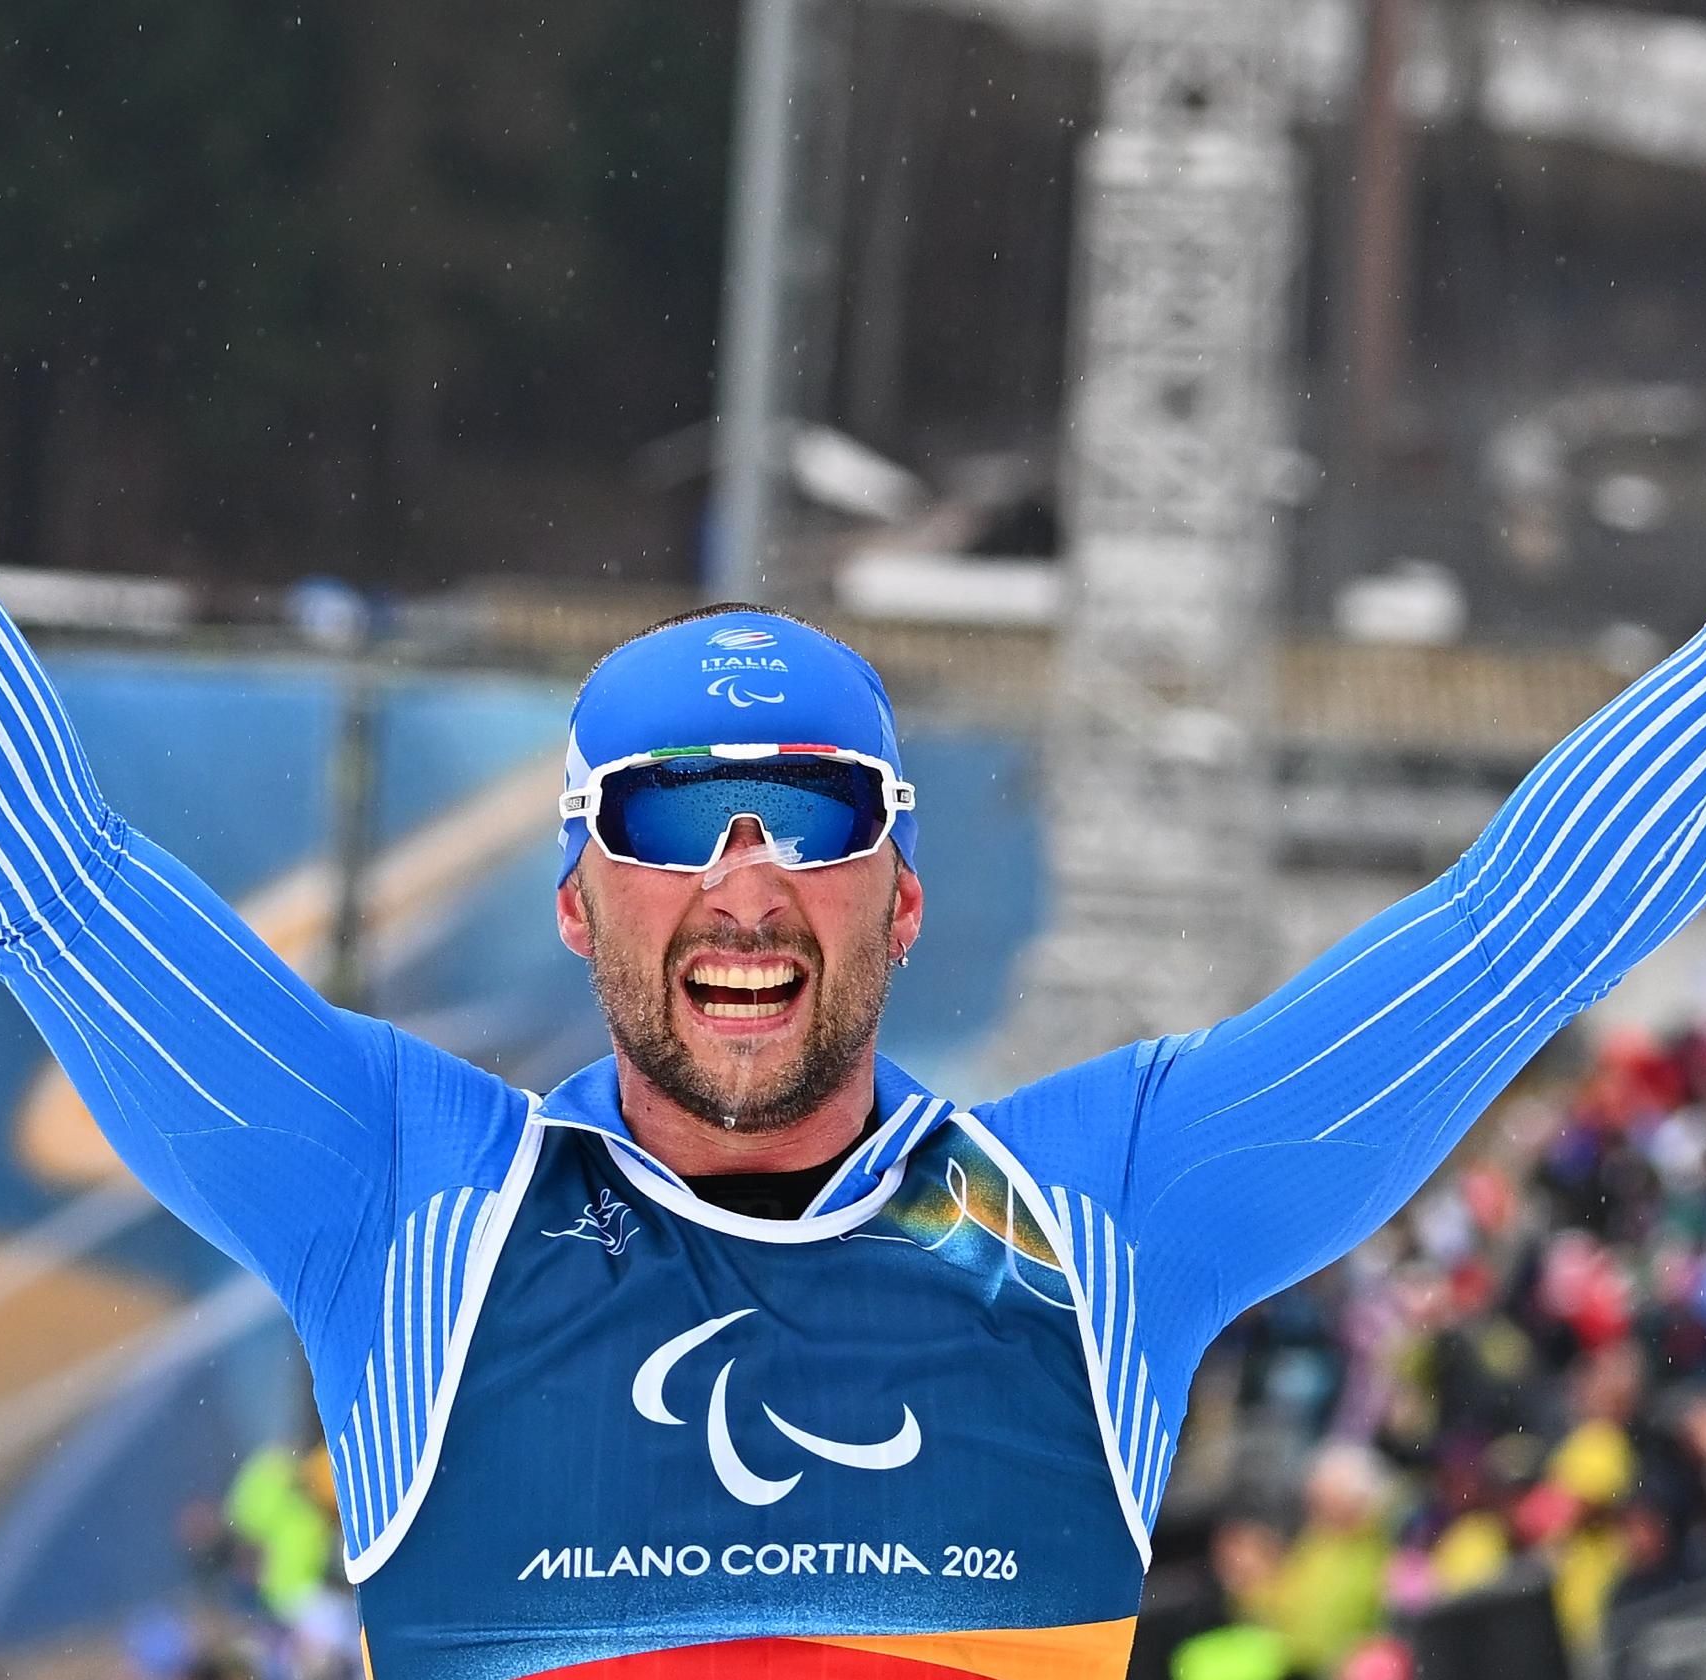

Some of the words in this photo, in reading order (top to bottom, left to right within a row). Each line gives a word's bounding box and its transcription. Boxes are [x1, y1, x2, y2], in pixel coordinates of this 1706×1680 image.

[701, 657, 787, 669] ITALIA
[517, 1545, 711, 1581] MILANO
[721, 1543, 931, 1576] CORTINA
[942, 1546, 1019, 1581] 2026
